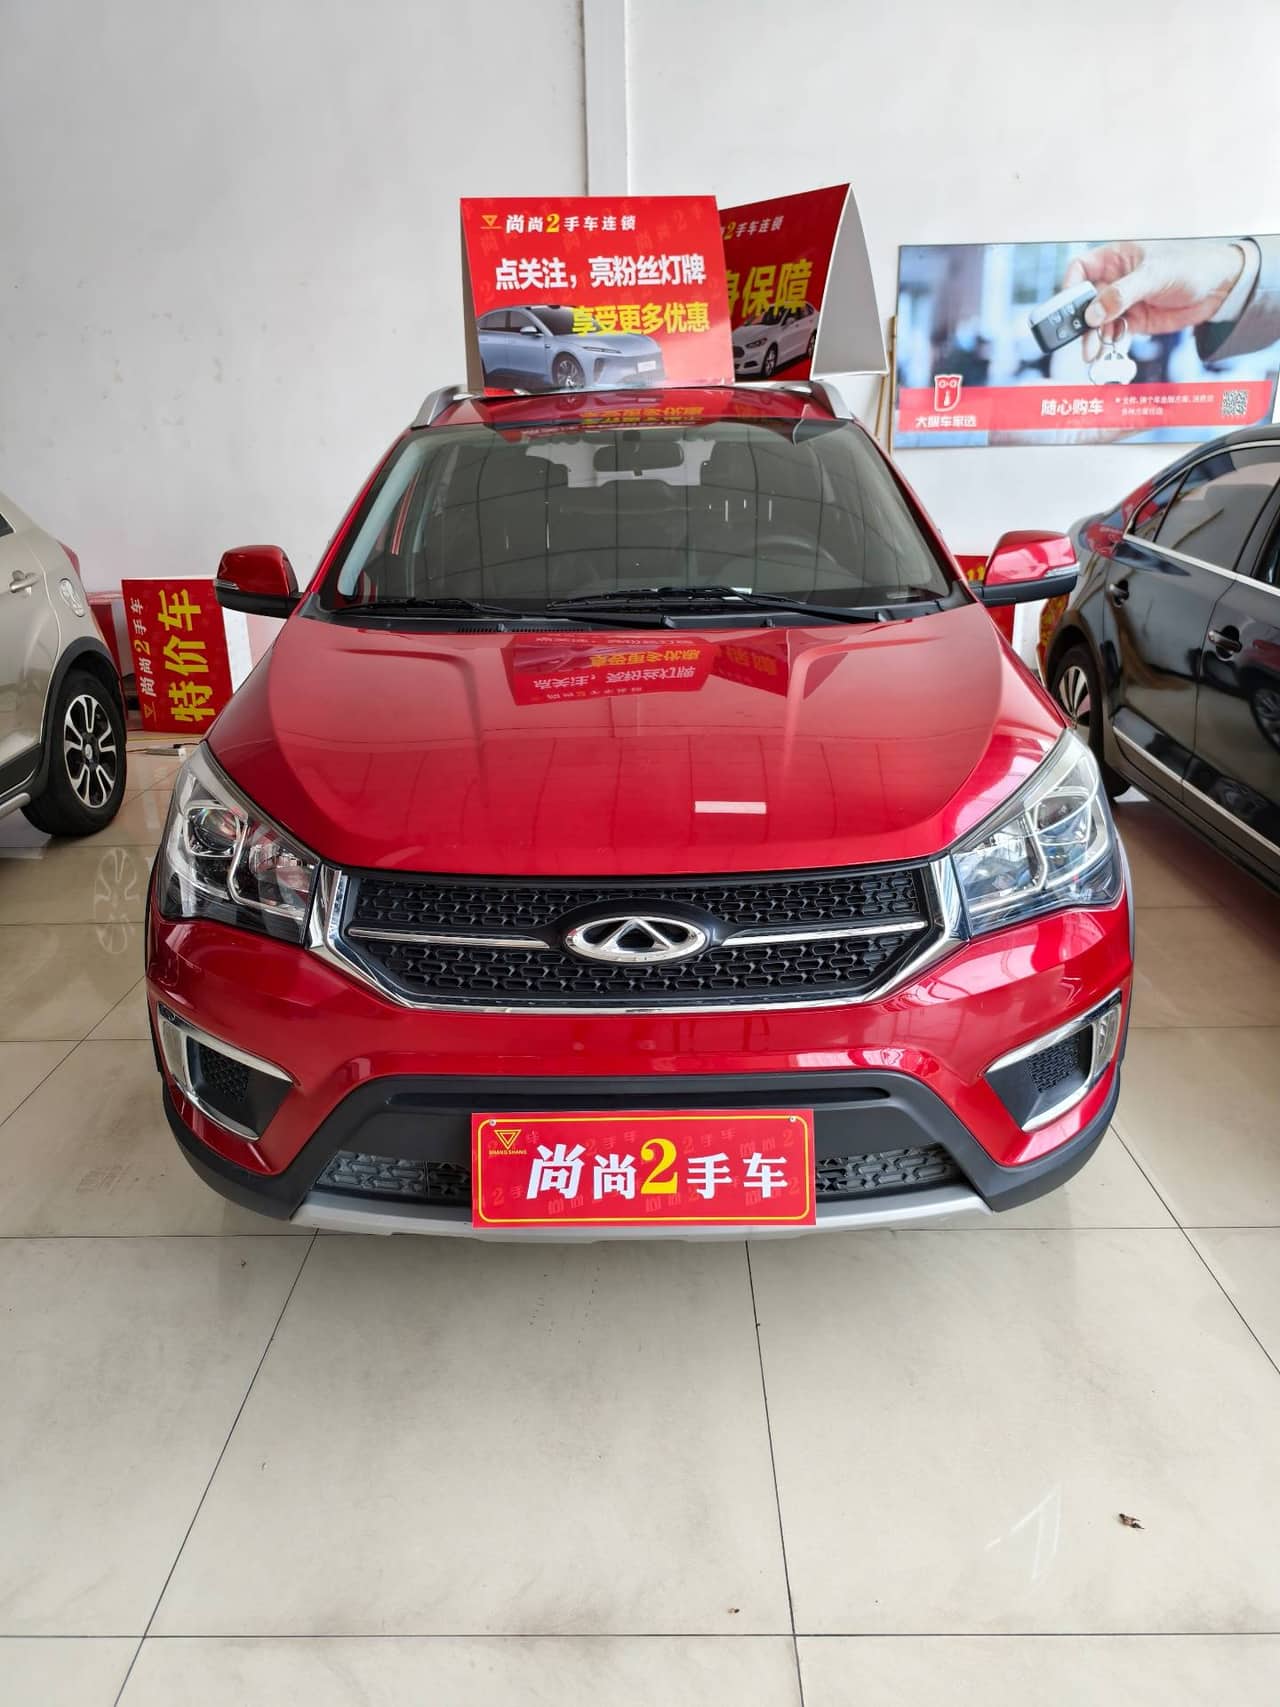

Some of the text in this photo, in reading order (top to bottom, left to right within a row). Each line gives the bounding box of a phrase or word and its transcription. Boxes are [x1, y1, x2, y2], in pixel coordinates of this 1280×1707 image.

[505, 213, 636, 234] 尚尚2手车连锁
[720, 215, 785, 240] 2手车连锁
[495, 253, 707, 291] 点关注，亮粉丝灯牌
[572, 302, 710, 336] 享受更多优惠
[1041, 398, 1105, 416] 随心购车
[130, 597, 158, 697] 尚尚2手车
[158, 590, 215, 722] 特价车
[526, 1137, 789, 1200] 尚尚2手车
